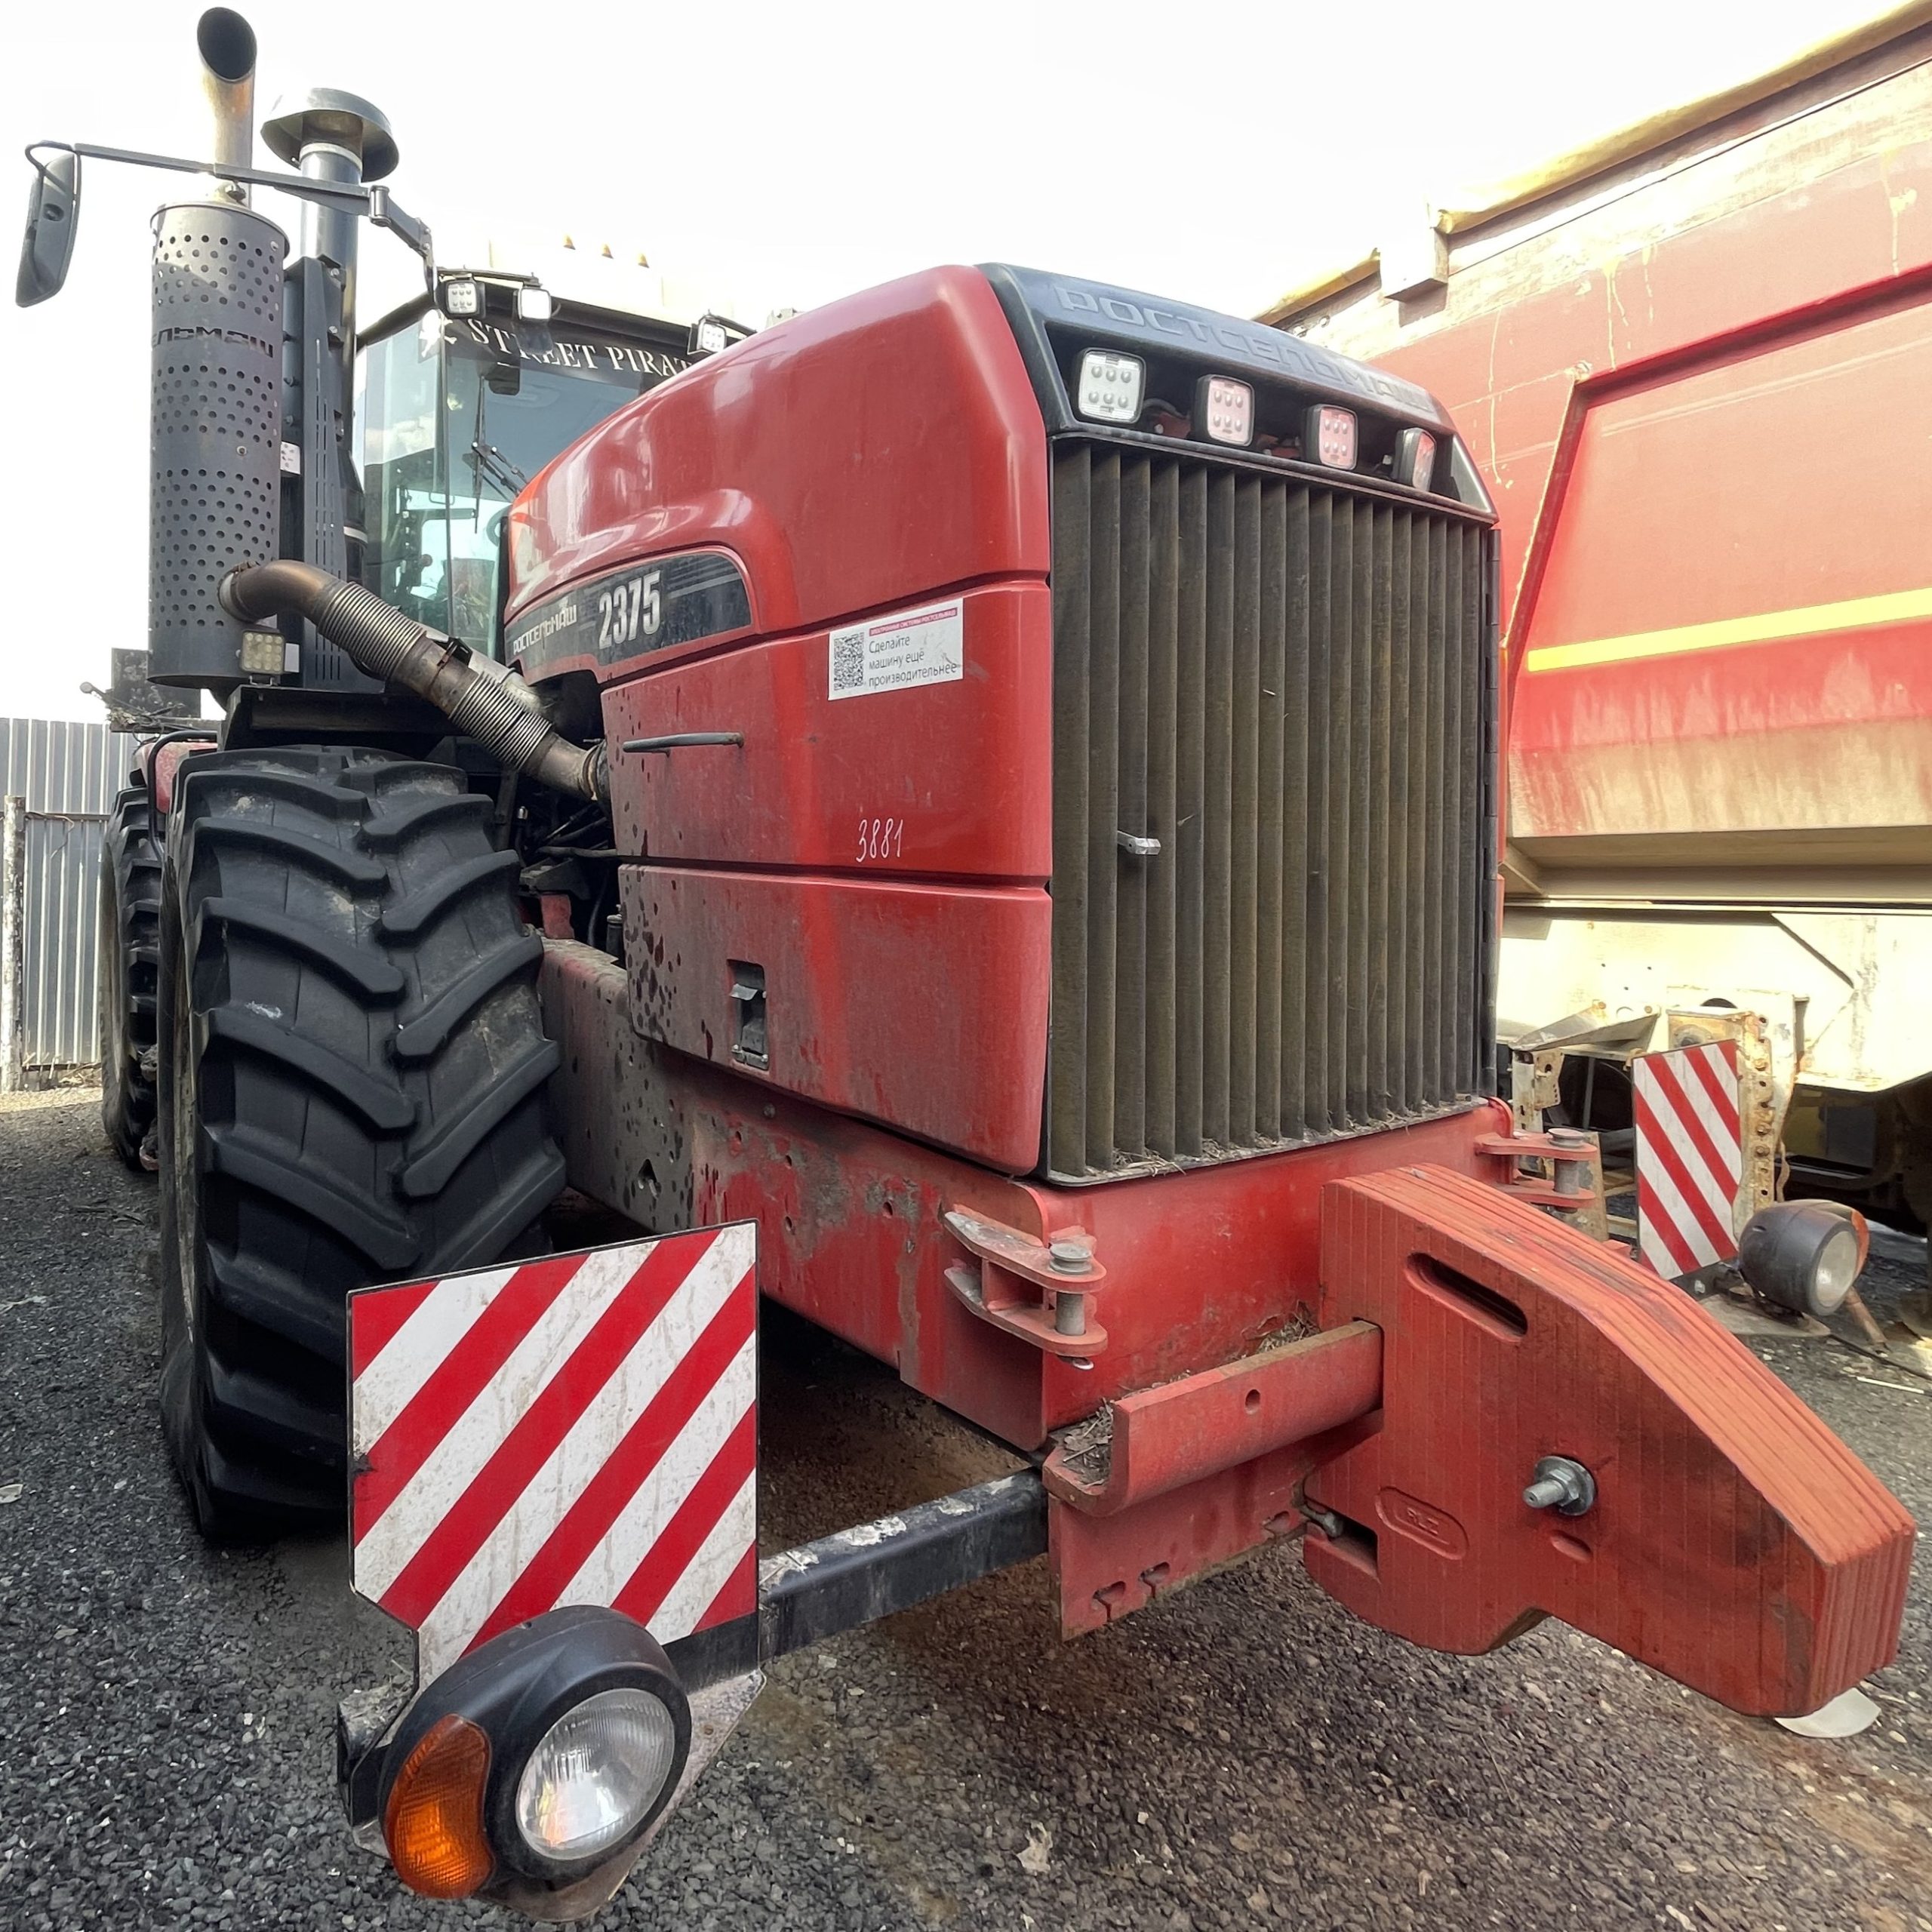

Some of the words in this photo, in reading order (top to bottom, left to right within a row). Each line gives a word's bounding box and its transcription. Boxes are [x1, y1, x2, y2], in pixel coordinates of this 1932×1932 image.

[1054, 285, 1434, 413] РОСТСЕЛЬМАШ
[513, 605, 577, 655] РОСТСЕЛЬМАШ
[598, 570, 661, 650] 2375
[869, 635, 910, 654] Сделайте
[869, 655, 903, 669] машину
[906, 648, 924, 663] ещё
[869, 663, 957, 689] производительнее
[856, 818, 903, 863] 3881
